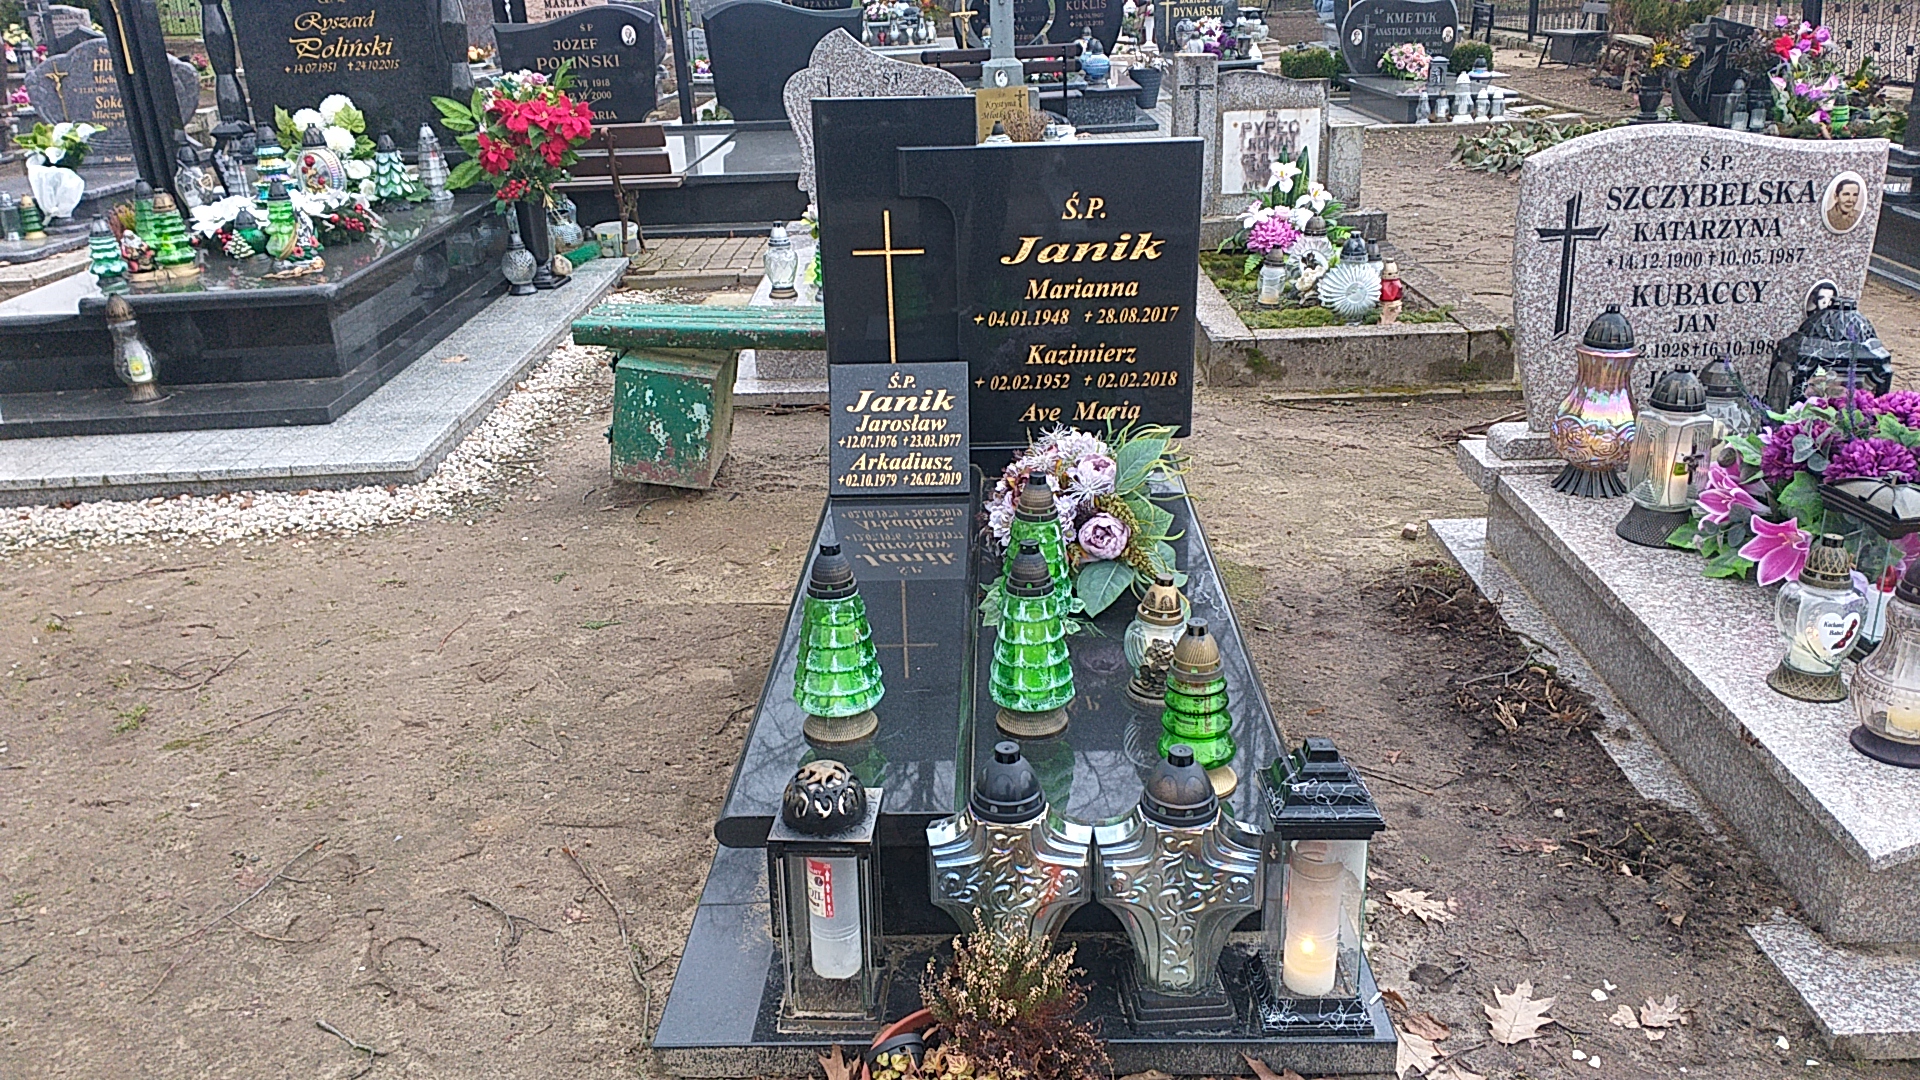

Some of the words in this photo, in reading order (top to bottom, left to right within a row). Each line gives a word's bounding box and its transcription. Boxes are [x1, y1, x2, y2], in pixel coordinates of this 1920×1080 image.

[1173, 5, 1223, 17] DYNARSKI
[1386, 12, 1437, 23] KMETYK
[294, 10, 375, 35] Ryszard
[288, 35, 393, 59] Poliński
[553, 38, 598, 50] JÓZEF
[593, 79, 610, 87] 1918
[592, 91, 612, 100] 2000
[592, 110, 617, 120] ARIA
[1061, 191, 1106, 219] Ś.P.
[1606, 180, 1816, 211] SZCZYBELSKA
[1633, 217, 1782, 242] KATARZYNA
[1000, 232, 1165, 265] Janik
[1024, 277, 1138, 300] Marianna
[1631, 281, 1770, 307] KUBACCY
[1674, 314, 1718, 333] JAN
[1025, 342, 1137, 365] Kazimierz
[887, 372, 916, 388] Ś.P.
[846, 389, 956, 412] Janik
[1018, 403, 1061, 422] Ave
[1072, 401, 1141, 421] Maria
[855, 414, 947, 432] Jarosław
[850, 452, 953, 470] Arkadiusz
